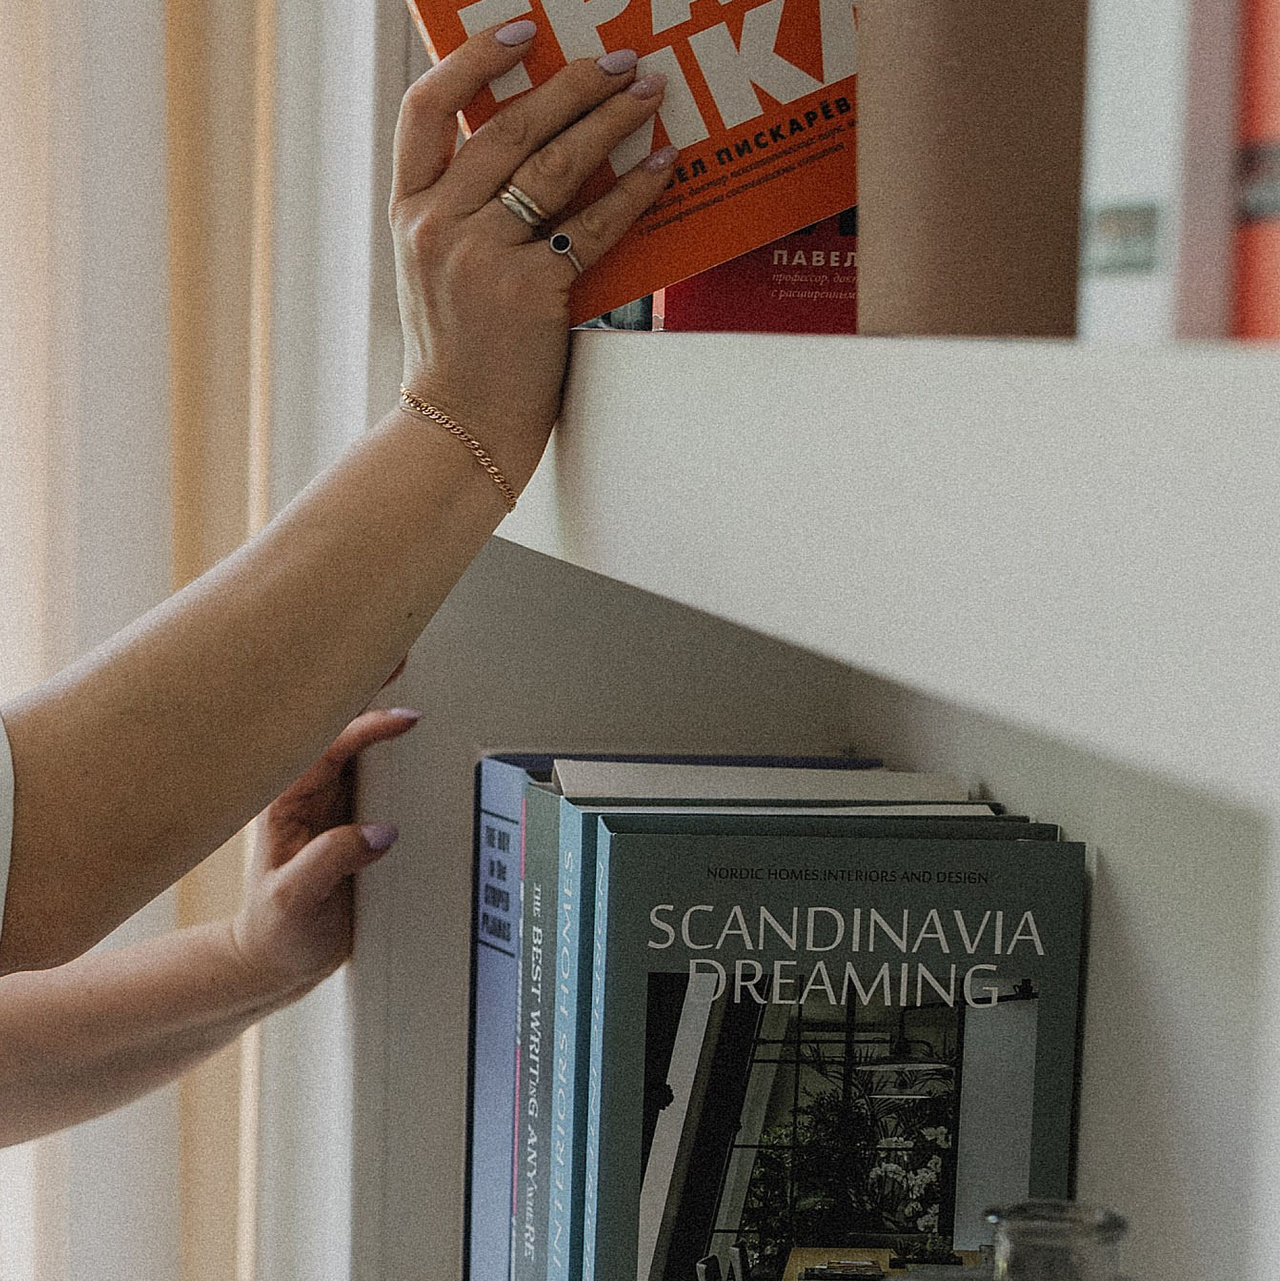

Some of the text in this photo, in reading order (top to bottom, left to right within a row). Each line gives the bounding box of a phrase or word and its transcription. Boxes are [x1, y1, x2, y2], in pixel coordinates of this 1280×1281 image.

[716, 96, 852, 166] ПИСКАРЁВ
[707, 867, 763, 880] NORDIC
[901, 870, 932, 883] AND
[936, 871, 988, 884] DESIGN
[647, 903, 1045, 956] SCANDINAVIA
[531, 925, 543, 1004] BEST
[688, 958, 1000, 1010] DREAMING
[527, 1008, 542, 1119] WRITING
